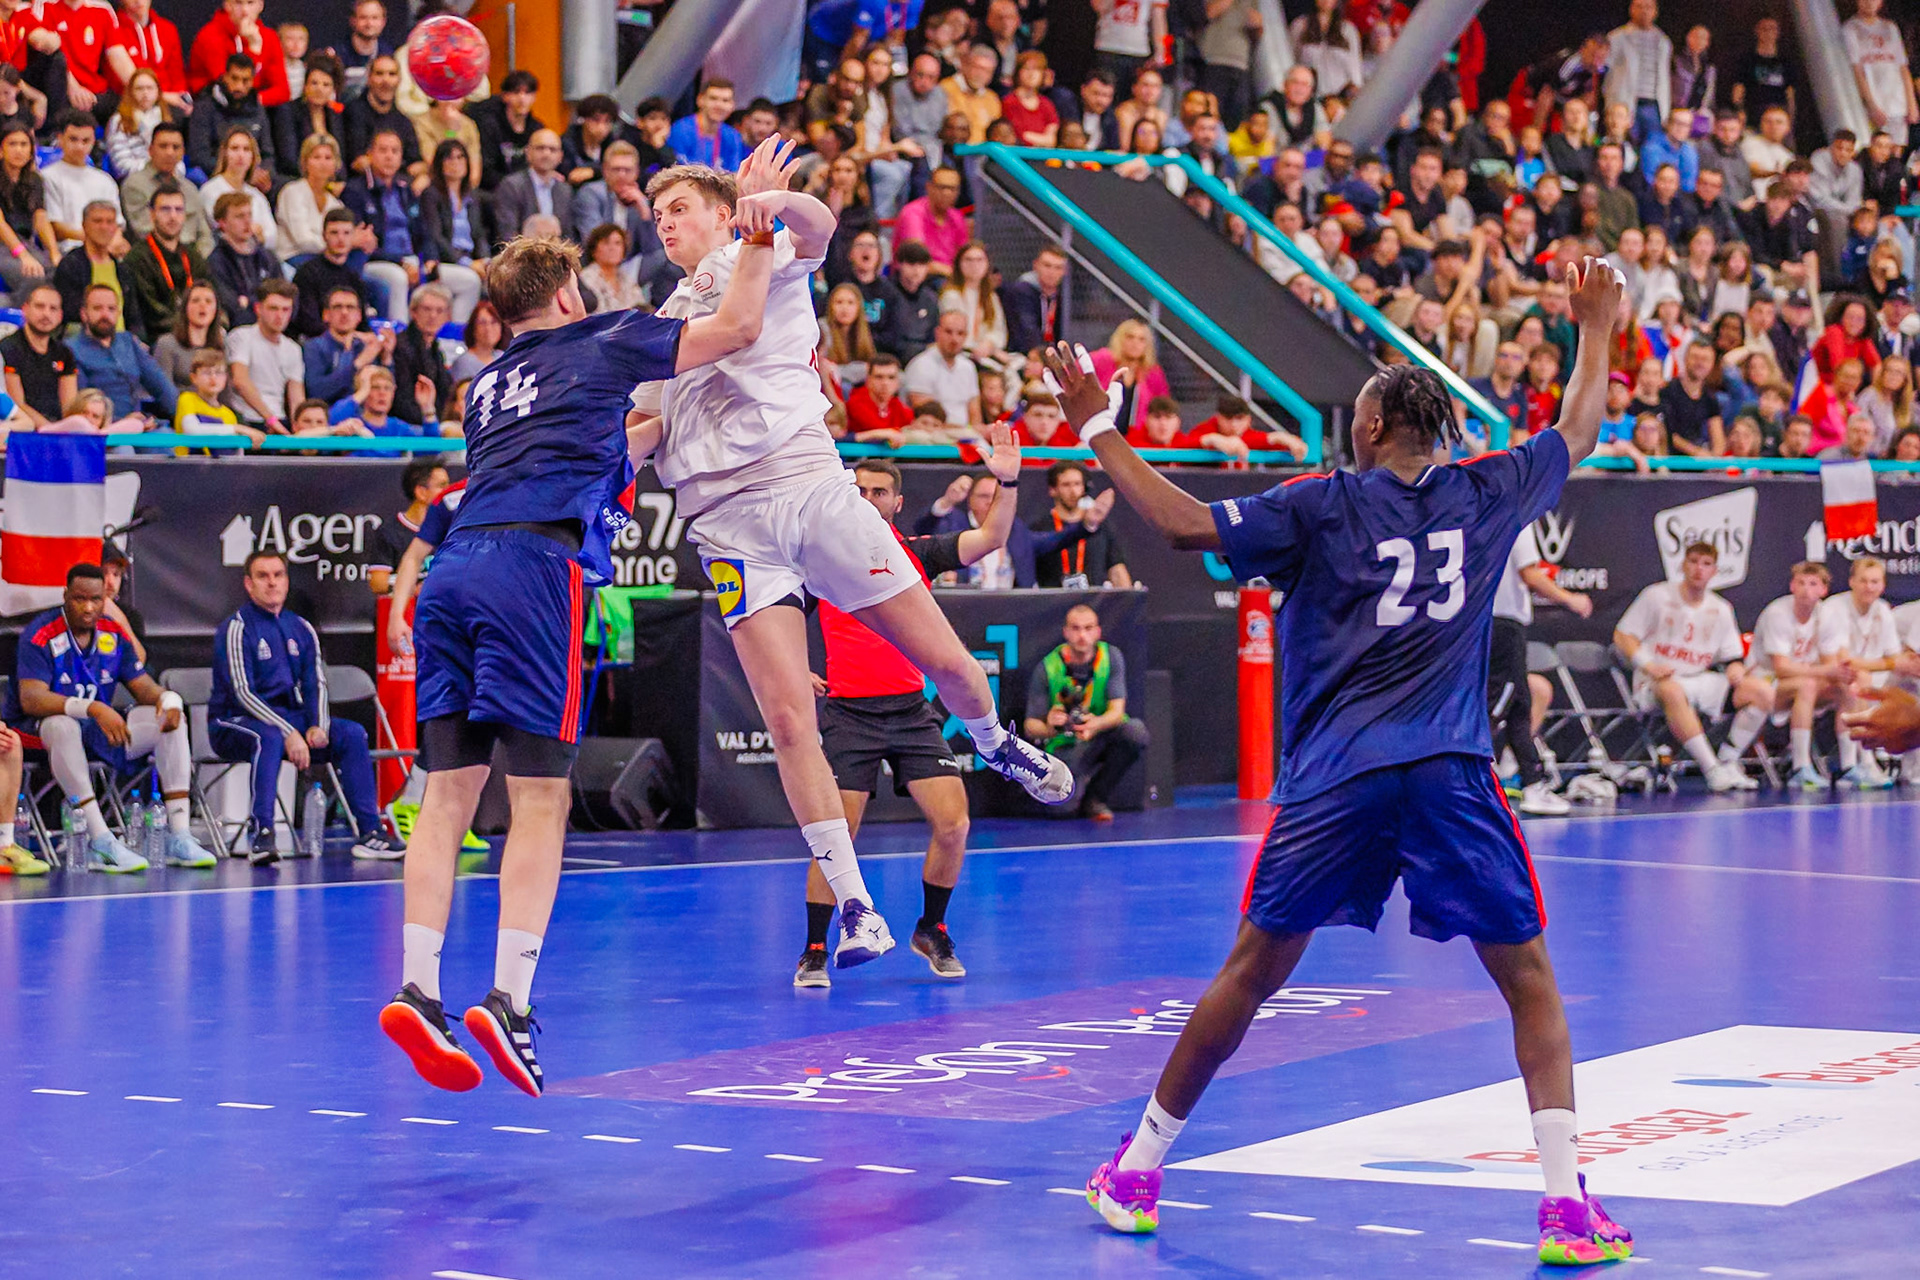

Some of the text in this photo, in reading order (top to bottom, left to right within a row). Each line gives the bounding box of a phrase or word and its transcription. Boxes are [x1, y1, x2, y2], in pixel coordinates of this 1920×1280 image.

[472, 361, 539, 431] 14
[1376, 529, 1466, 626] 23
[716, 731, 749, 750] VAL
